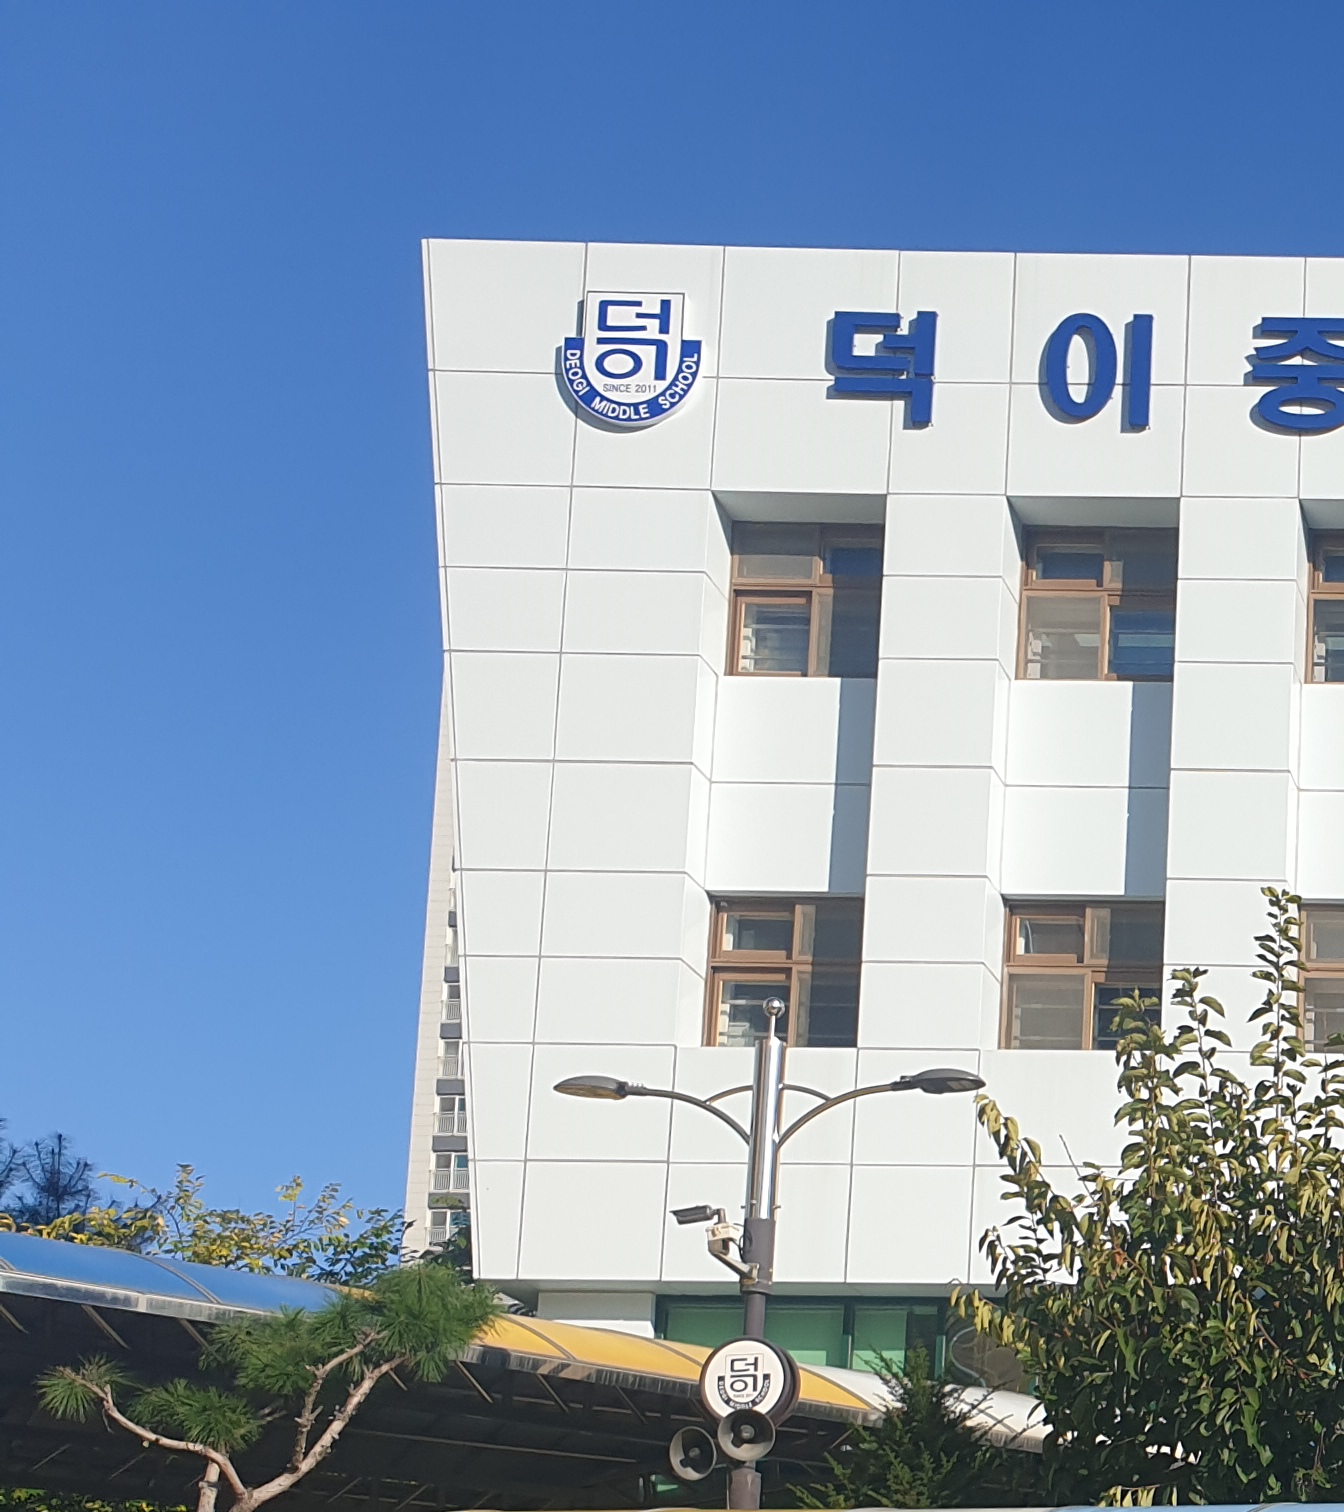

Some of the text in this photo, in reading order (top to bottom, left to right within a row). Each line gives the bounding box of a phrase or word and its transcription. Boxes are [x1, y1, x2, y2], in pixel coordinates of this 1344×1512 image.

[566, 349, 698, 419] DEOGI MIDDLE SCHOOL
[602, 383, 657, 393] SINCE 2011
